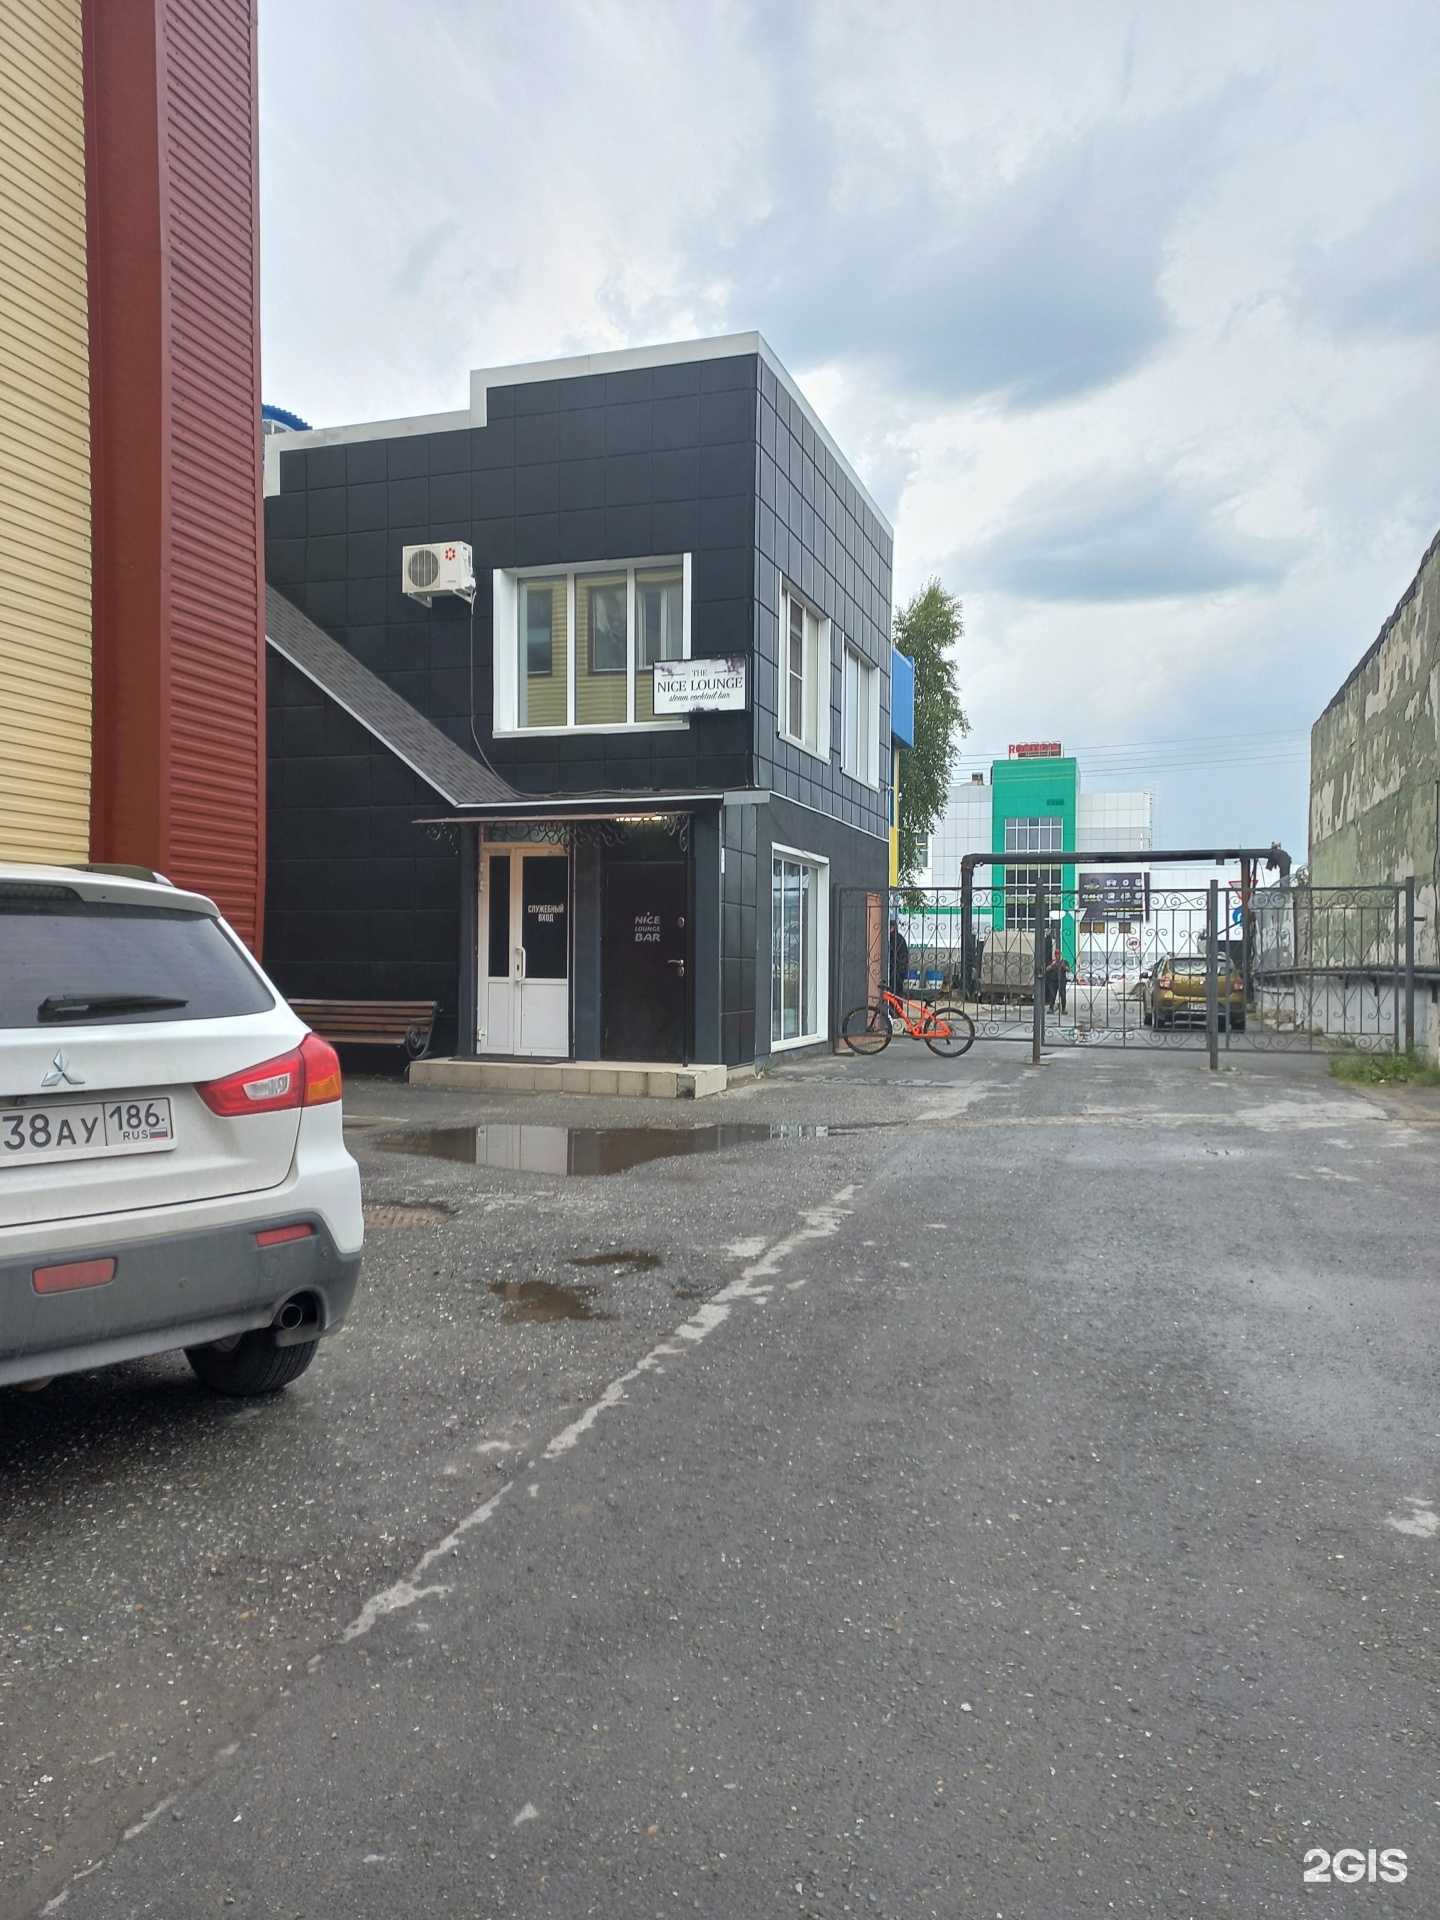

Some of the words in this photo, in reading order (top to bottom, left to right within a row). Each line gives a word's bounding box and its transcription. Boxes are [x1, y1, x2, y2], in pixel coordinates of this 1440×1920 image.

[692, 669, 707, 678] THE
[657, 680, 687, 693] NICE
[691, 677, 743, 691] LOUNGE
[669, 694, 689, 702] steam
[690, 691, 717, 701] cocktail
[717, 692, 731, 700] bar
[528, 903, 565, 914] СЛУЖЕБНЫЙ
[538, 913, 554, 923] ВХОД
[635, 933, 661, 942] BAR
[109, 1103, 160, 1131] 186
[123, 1130, 149, 1141] RUS
